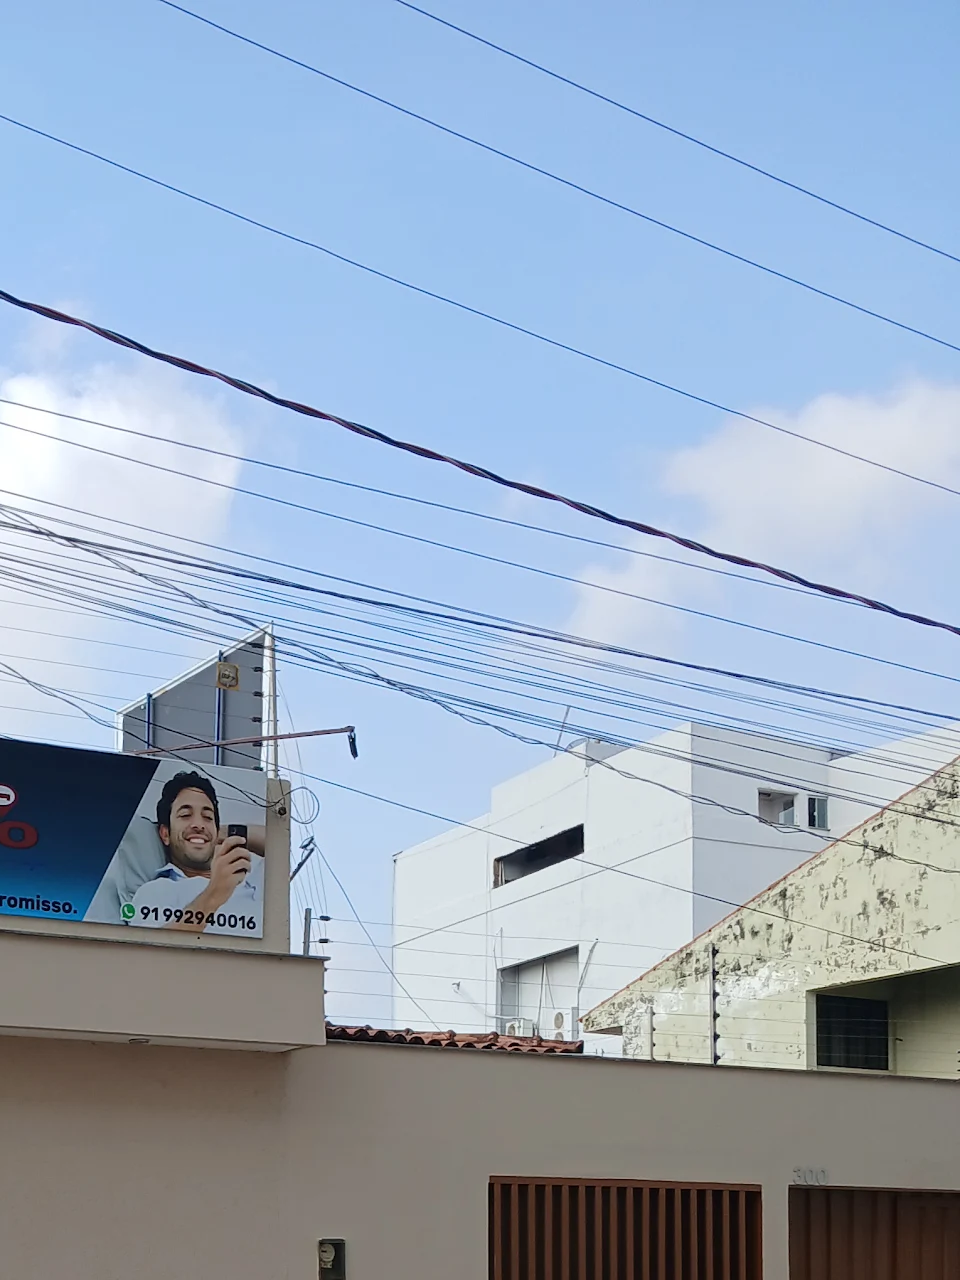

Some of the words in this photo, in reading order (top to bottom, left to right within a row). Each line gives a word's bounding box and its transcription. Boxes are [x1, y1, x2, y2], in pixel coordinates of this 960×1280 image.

[140, 906, 159, 921] 91
[162, 908, 257, 930] 992940016
[792, 1166, 828, 1185] 300
